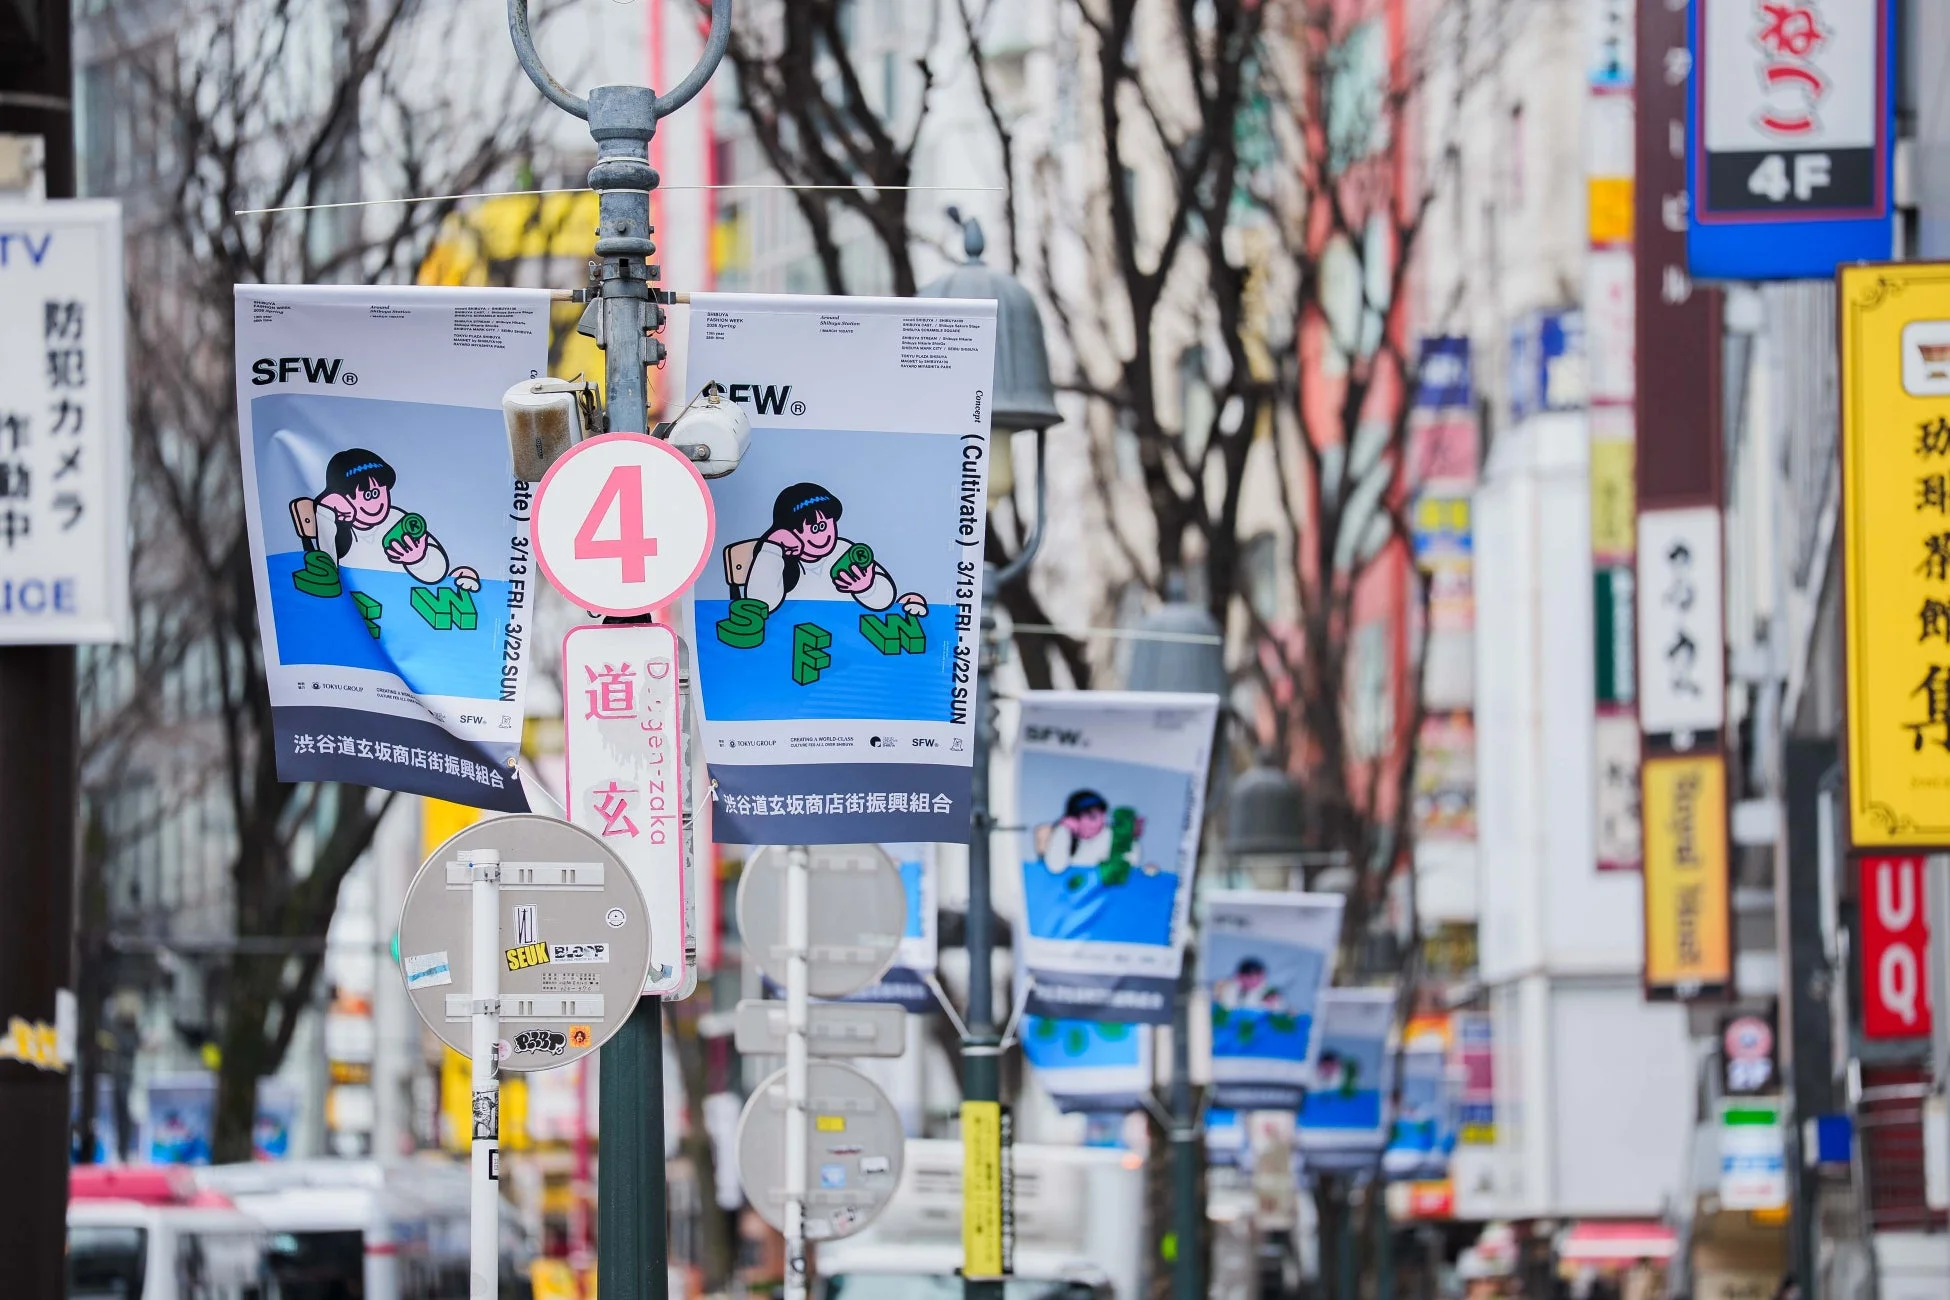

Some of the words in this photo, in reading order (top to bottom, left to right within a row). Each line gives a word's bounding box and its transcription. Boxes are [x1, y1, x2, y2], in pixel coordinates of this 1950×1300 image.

[1747, 154, 1832, 201] 4F
[44, 299, 85, 532] 防犯カメラ
[574, 464, 658, 584] 4
[509, 536, 529, 575] 3/13
[506, 579, 525, 609] FRI
[955, 561, 975, 600] 3/13
[955, 603, 972, 631] FRI
[502, 623, 523, 662] 3/22
[499, 665, 518, 702] SUN
[951, 646, 971, 683] 3/22
[949, 684, 967, 725] SUN
[293, 733, 505, 789] 渋谷道玄坂商店街振興組合
[723, 792, 953, 816] 渋谷道玄坂商店街振興組合
[506, 943, 549, 970] SEUK
[1876, 861, 1917, 1026] UQ
